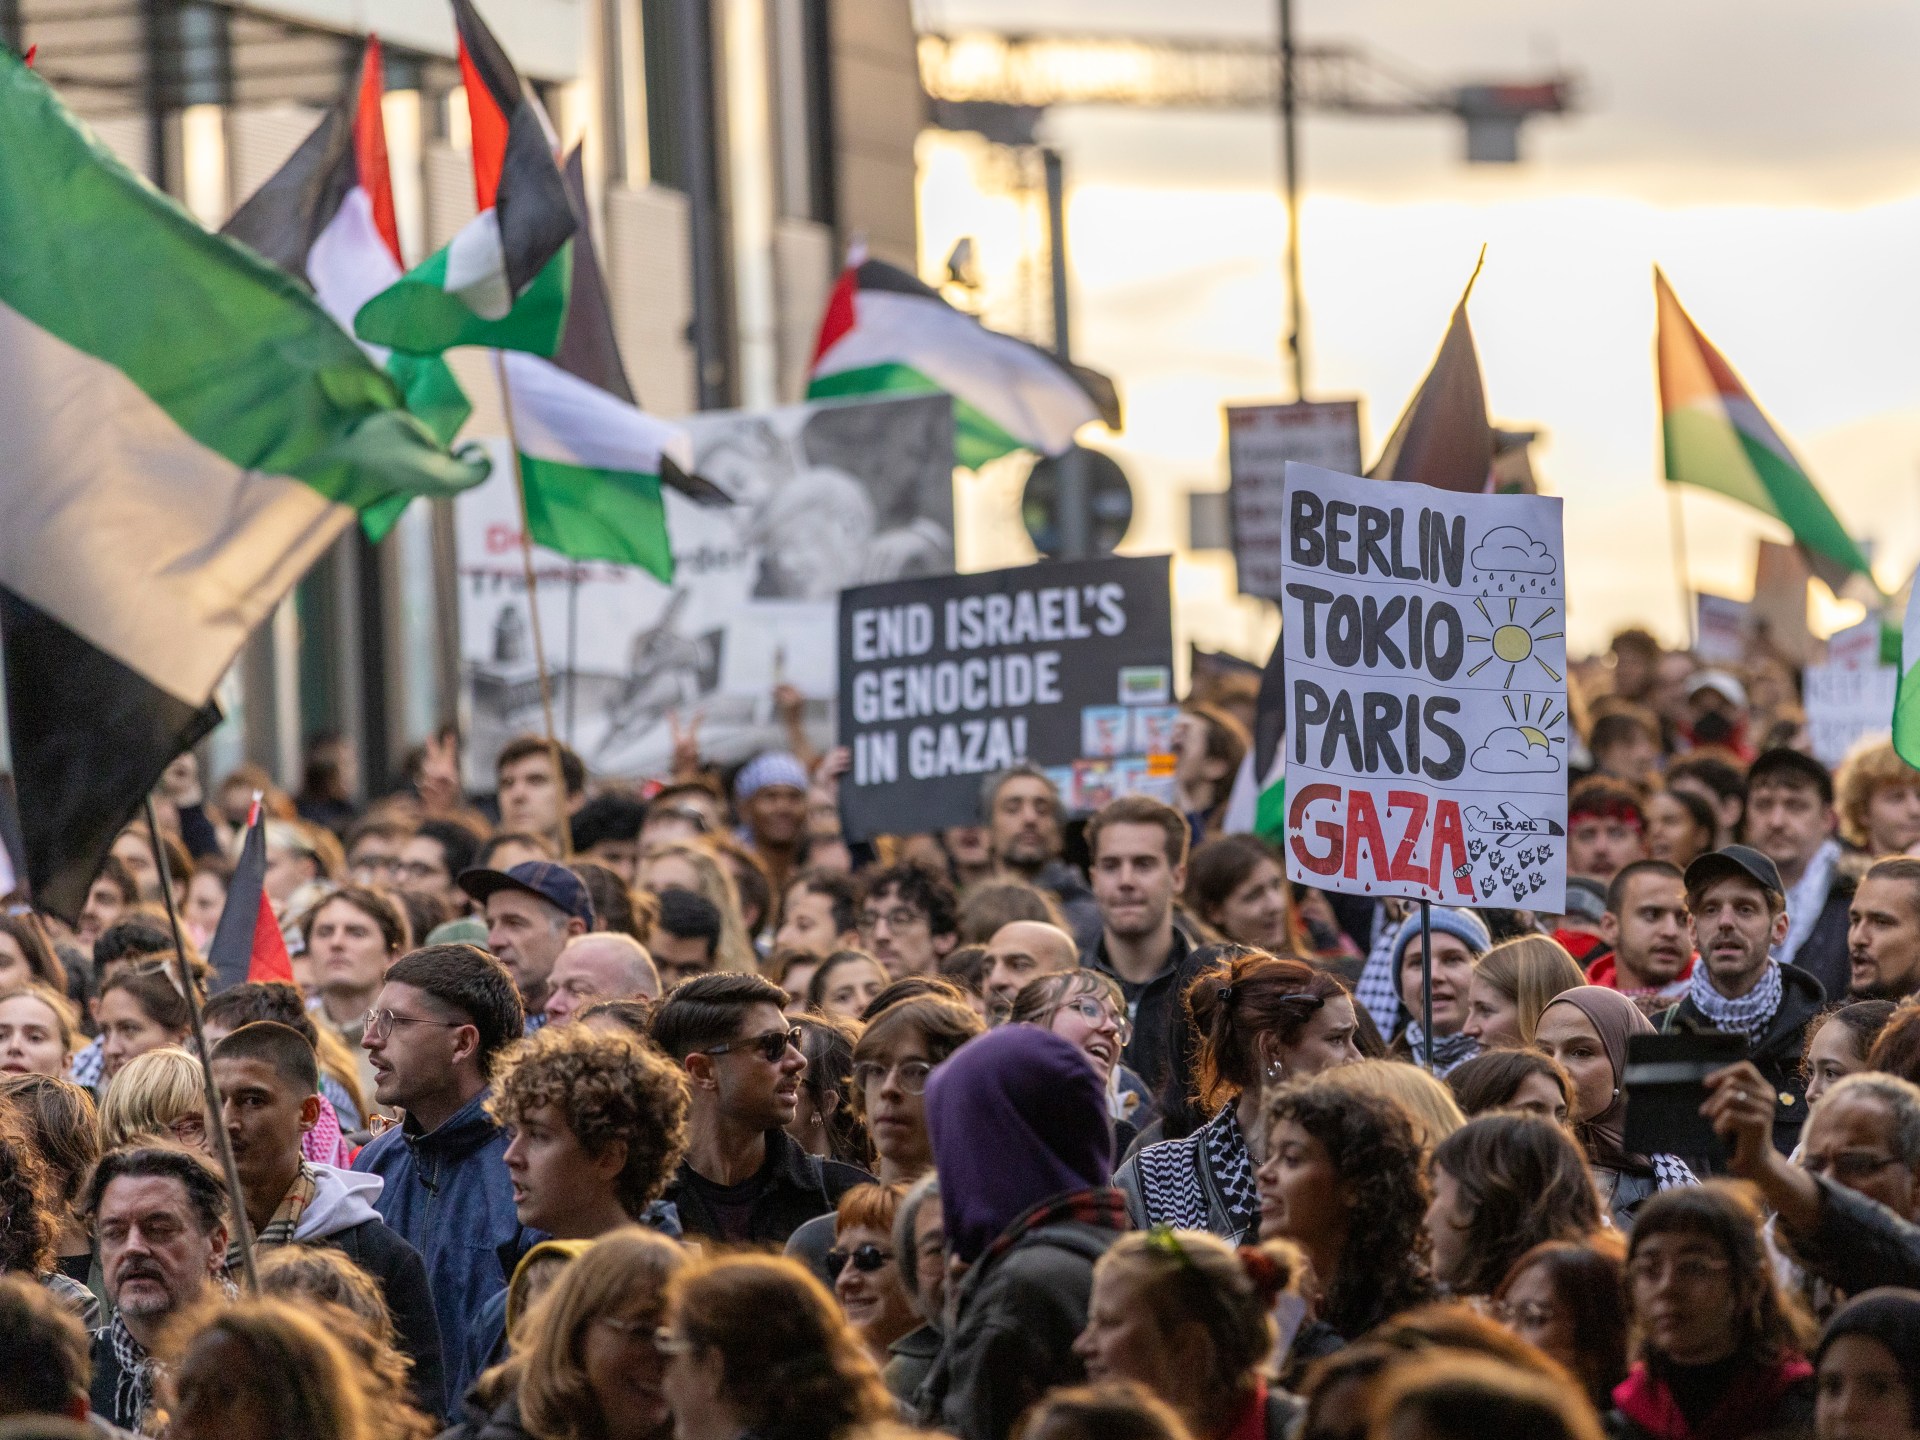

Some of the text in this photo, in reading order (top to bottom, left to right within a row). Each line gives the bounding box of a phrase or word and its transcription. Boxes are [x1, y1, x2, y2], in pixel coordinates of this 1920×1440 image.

[1290, 489, 1466, 588] BERLIN
[852, 582, 1127, 662] END ISRAEL'S
[1285, 582, 1465, 682] TOKIO
[852, 650, 1063, 723] GENOCIDE
[1293, 679, 1467, 781] PARIS
[853, 730, 898, 786] IN
[907, 715, 1028, 780] GAZA!
[1288, 782, 1475, 898] GAZA
[1492, 820, 1537, 832] ISRAEL
